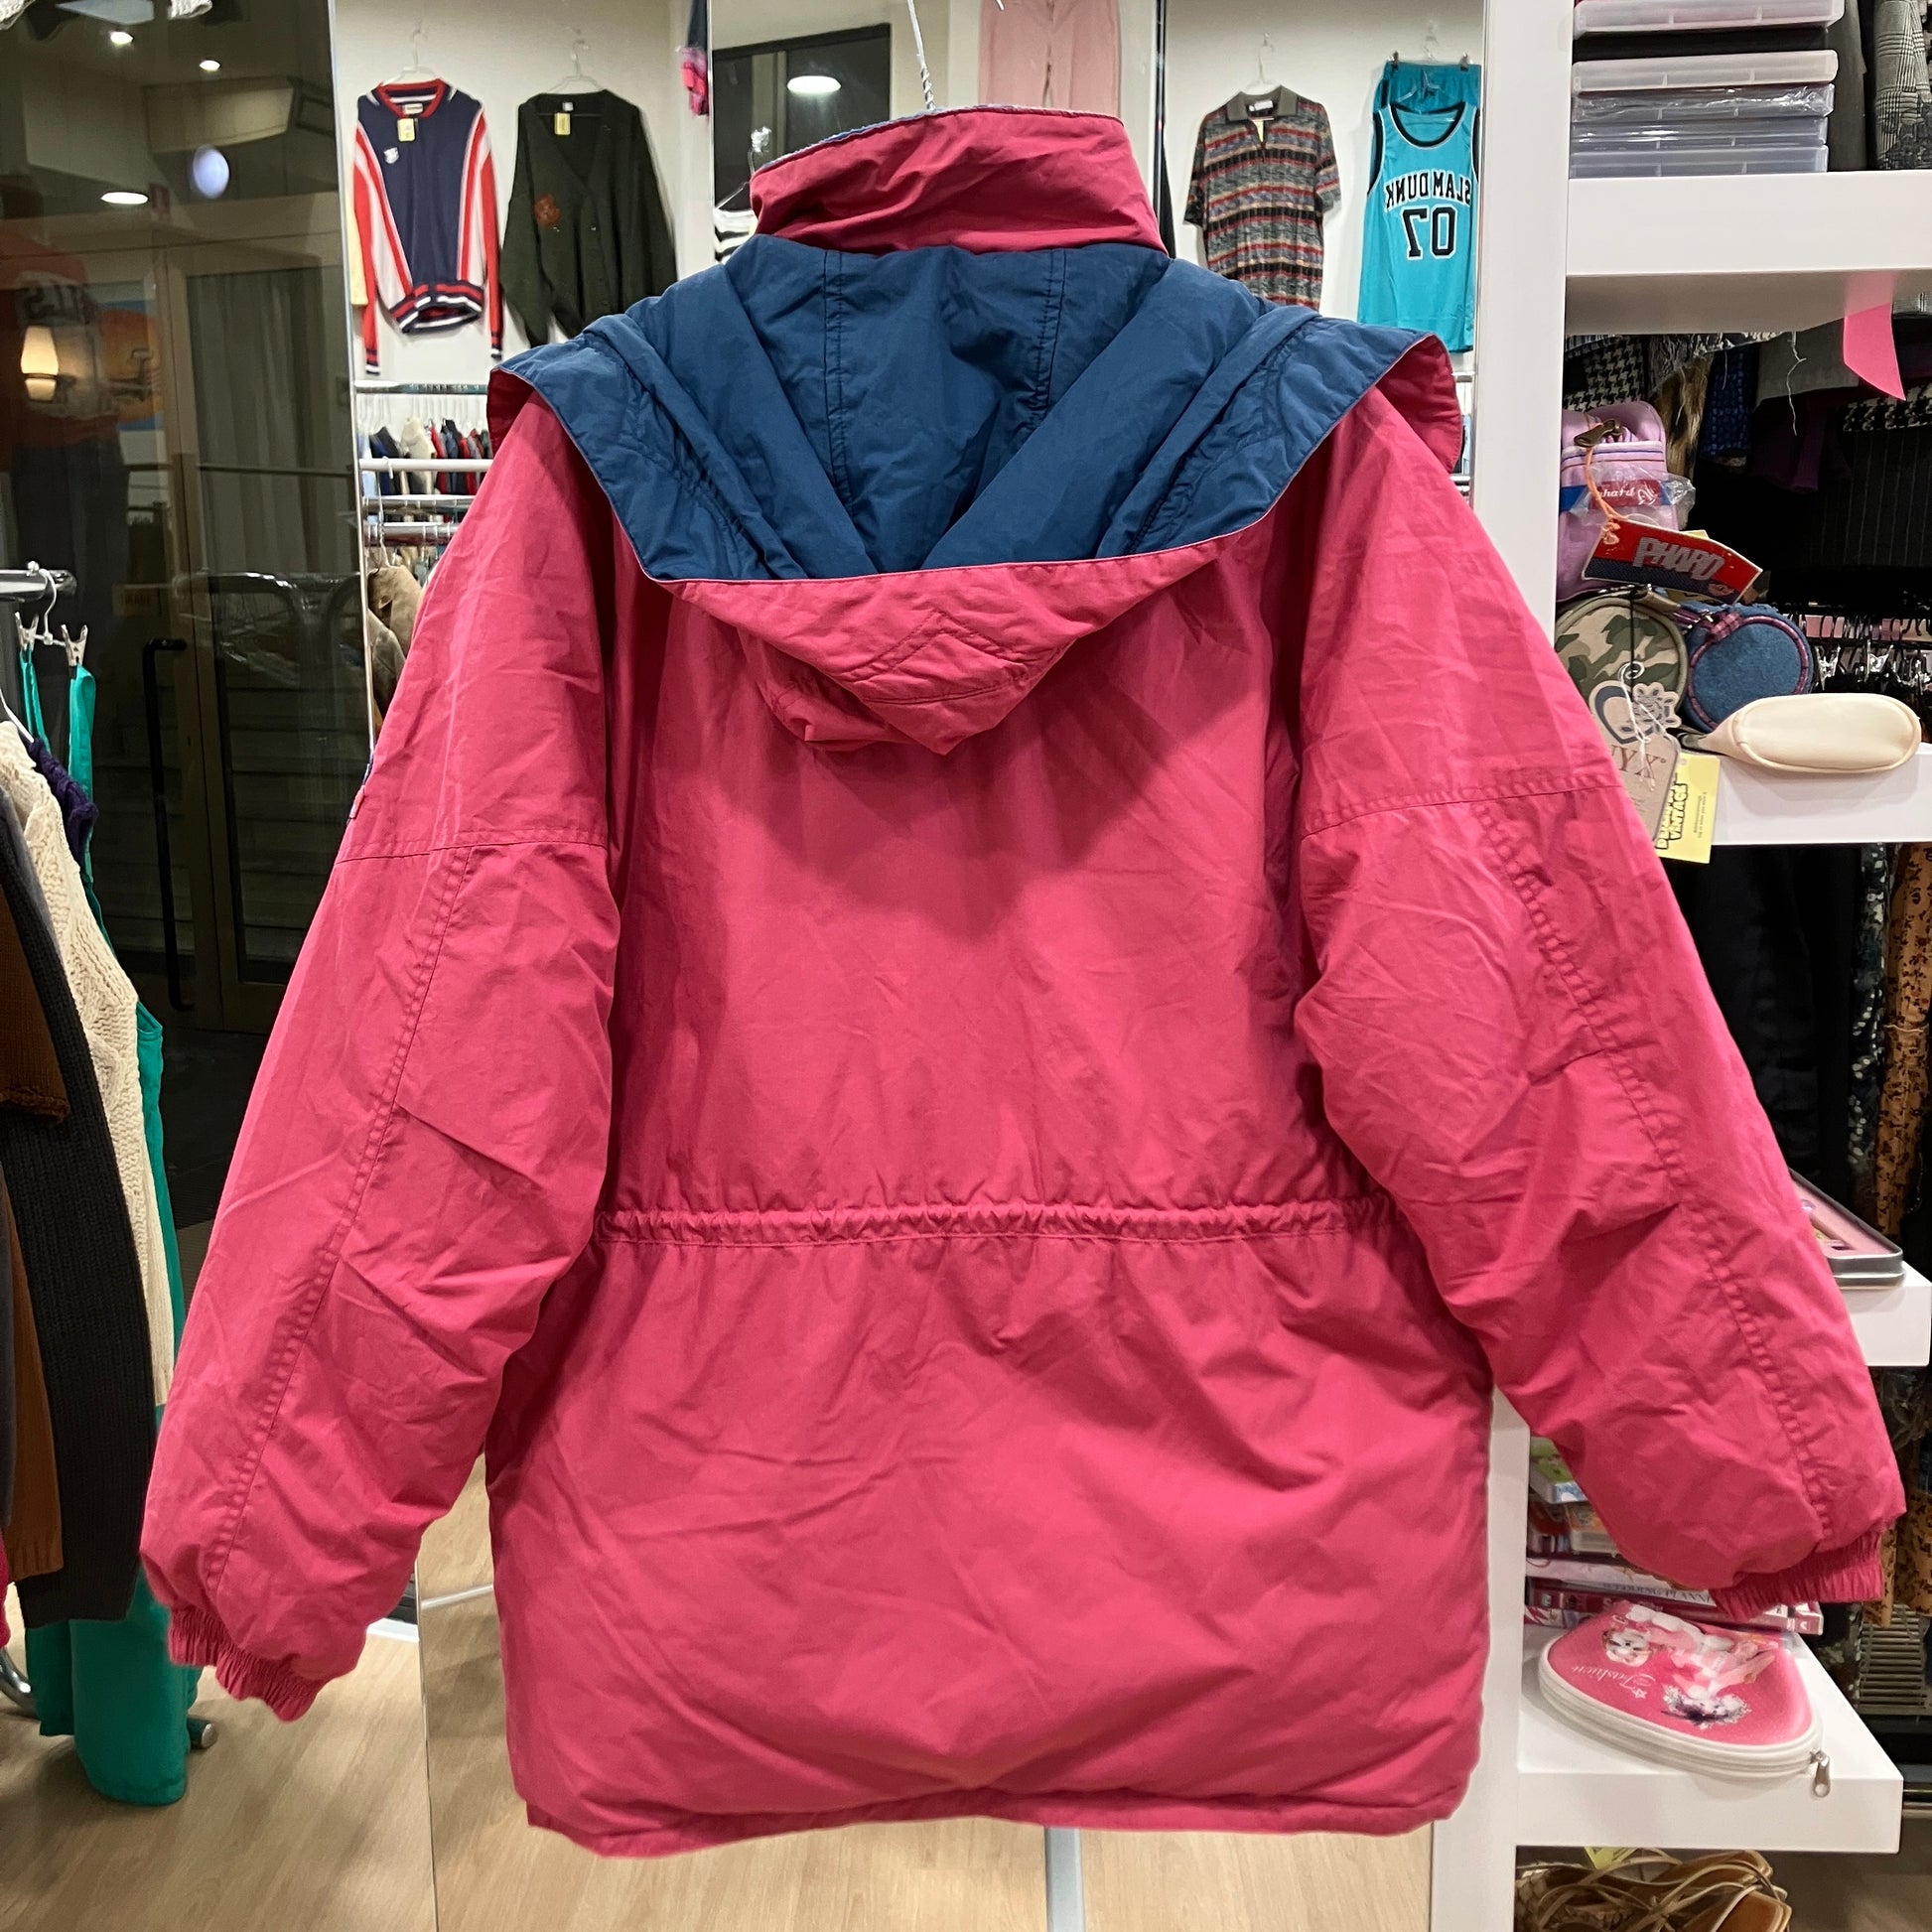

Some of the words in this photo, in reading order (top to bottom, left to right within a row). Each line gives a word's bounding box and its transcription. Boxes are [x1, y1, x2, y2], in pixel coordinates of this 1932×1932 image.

[1599, 486, 1636, 498] hard
[1633, 537, 1725, 581] PHARD
[1572, 1665, 1656, 1690] Fashion
